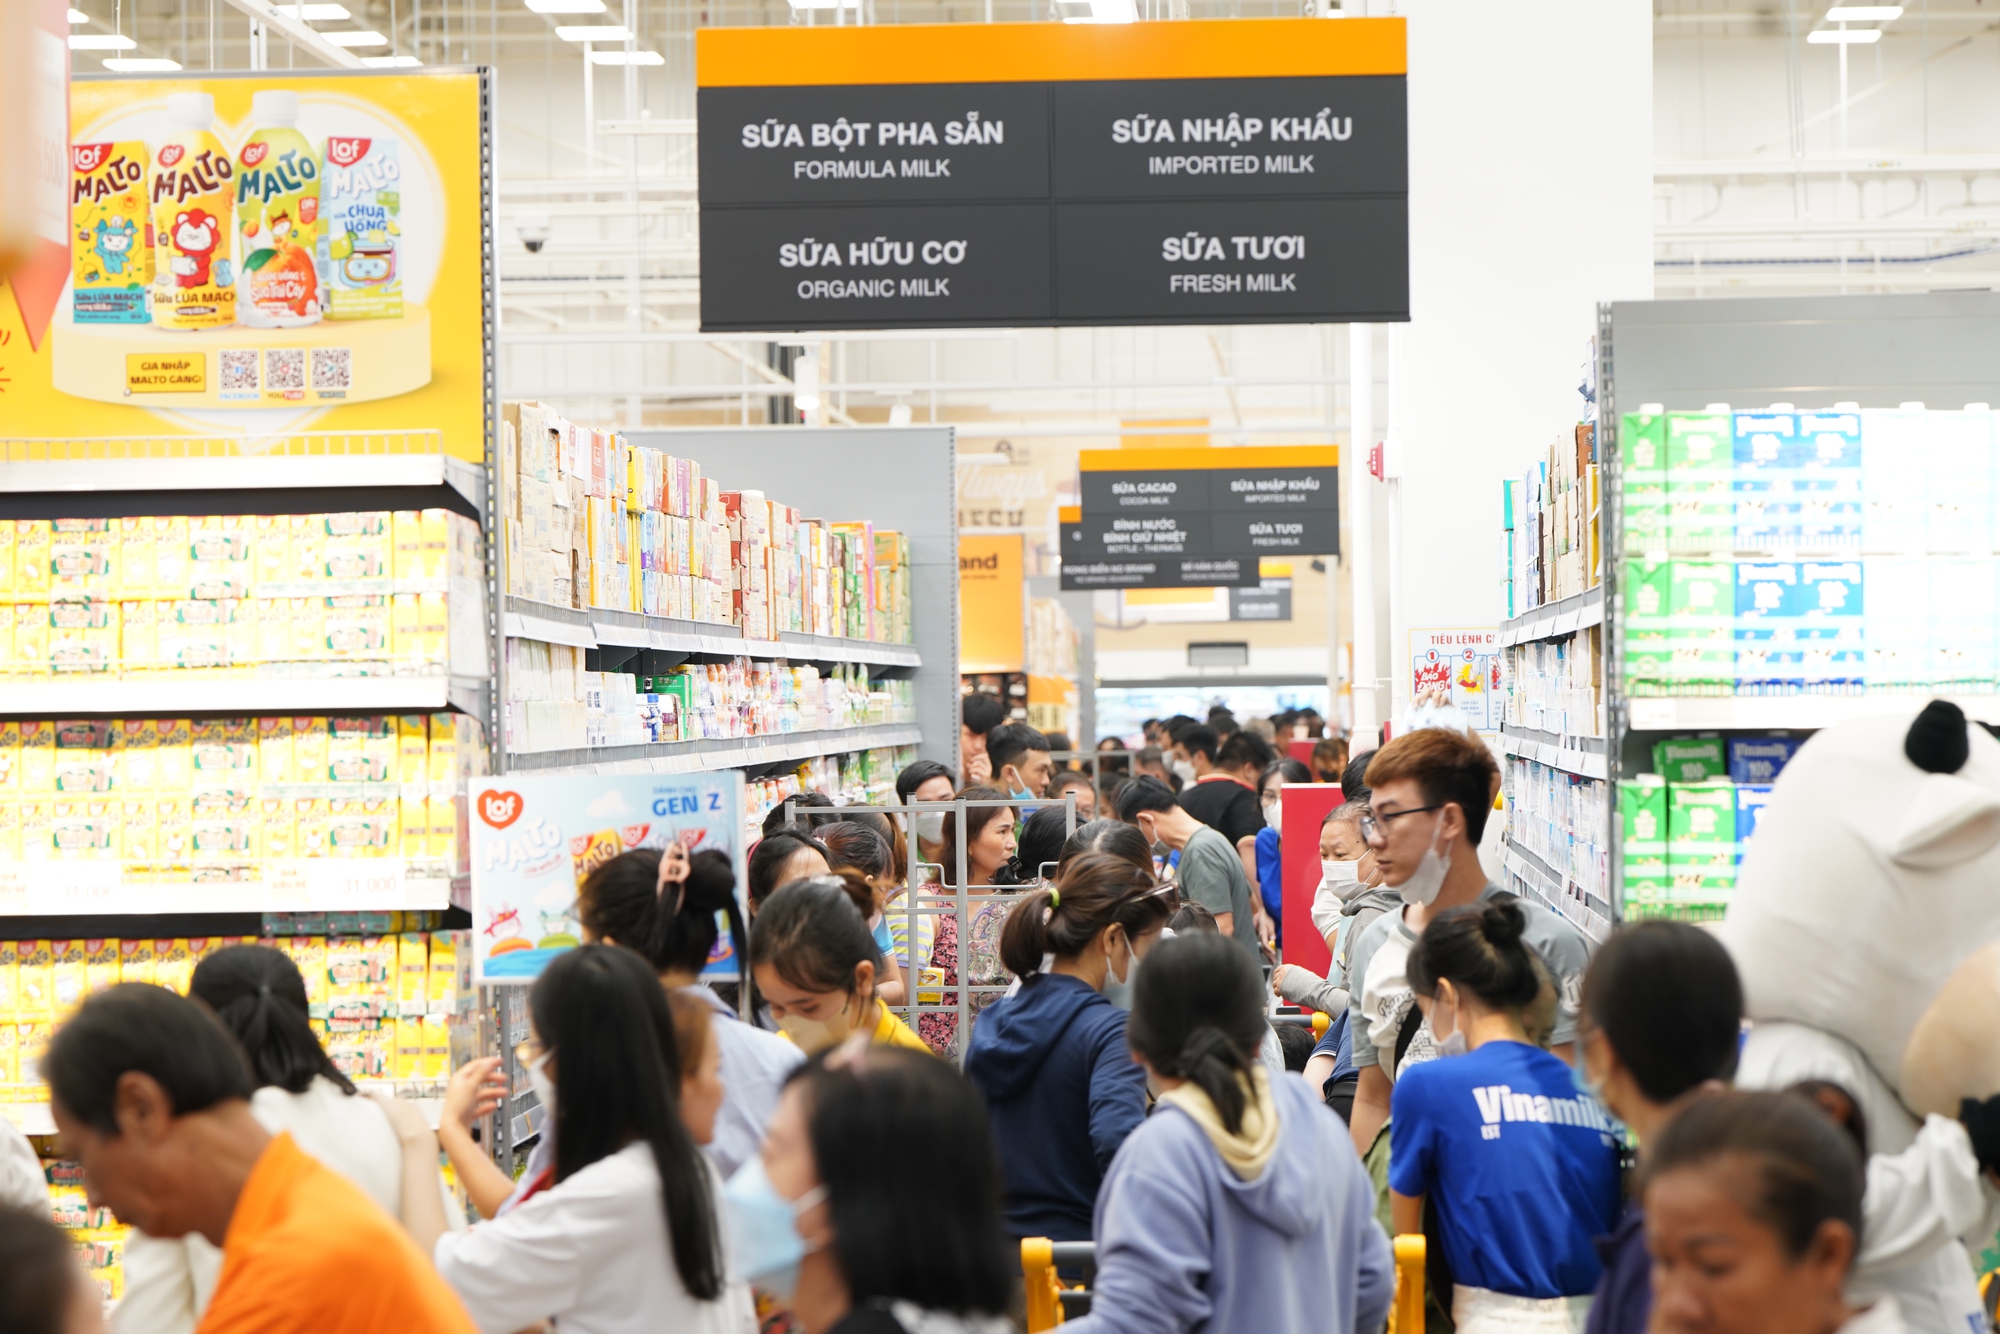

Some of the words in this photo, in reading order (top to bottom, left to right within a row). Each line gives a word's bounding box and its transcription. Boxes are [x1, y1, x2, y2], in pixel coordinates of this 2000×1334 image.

[742, 119, 804, 148] SỮA
[812, 117, 871, 152] BỘT
[878, 121, 938, 147] PHA
[945, 111, 1003, 146] SẴN
[1112, 114, 1175, 144] SỮA
[1182, 112, 1263, 148] NHẬP
[1271, 107, 1352, 142] KHẨU
[75, 145, 101, 165] lof
[163, 147, 181, 160] lof
[245, 145, 264, 160] lof
[332, 139, 359, 159] lof
[794, 159, 896, 180] FORMULA
[900, 158, 950, 178] MILK
[1149, 156, 1259, 175] IMPORTED
[1265, 155, 1314, 174] MILK
[73, 155, 141, 204] MALTO
[153, 150, 232, 204] MALTO
[238, 150, 316, 204] MALTO
[330, 153, 399, 200] MALTO
[349, 204, 385, 219] CHUA
[780, 238, 841, 268] SỮA
[849, 237, 914, 266] HỮU
[922, 240, 967, 265] CƠ
[1162, 233, 1223, 262] SỮA
[1231, 236, 1305, 260] TƯƠI
[797, 279, 896, 299] ORGANIC
[901, 278, 950, 297] MILK
[1170, 274, 1242, 293] FRESH
[1247, 273, 1296, 292] MILK
[175, 290, 199, 303] LÚA
[141, 362, 159, 371] GIA
[161, 360, 191, 374] NHẬP
[131, 376, 167, 384] MALTO
[1137, 482, 1177, 494] CACAO
[1231, 478, 1256, 493] SỮA
[1249, 523, 1273, 536] SỮA
[1275, 523, 1304, 535] TƯƠI
[1429, 652, 1435, 660] 1
[1465, 650, 1473, 659] 2
[1421, 669, 1439, 681] BÁO
[485, 796, 515, 819] lof
[651, 795, 699, 817] GEN
[707, 792, 721, 811] Z
[484, 818, 561, 872] MALTO
